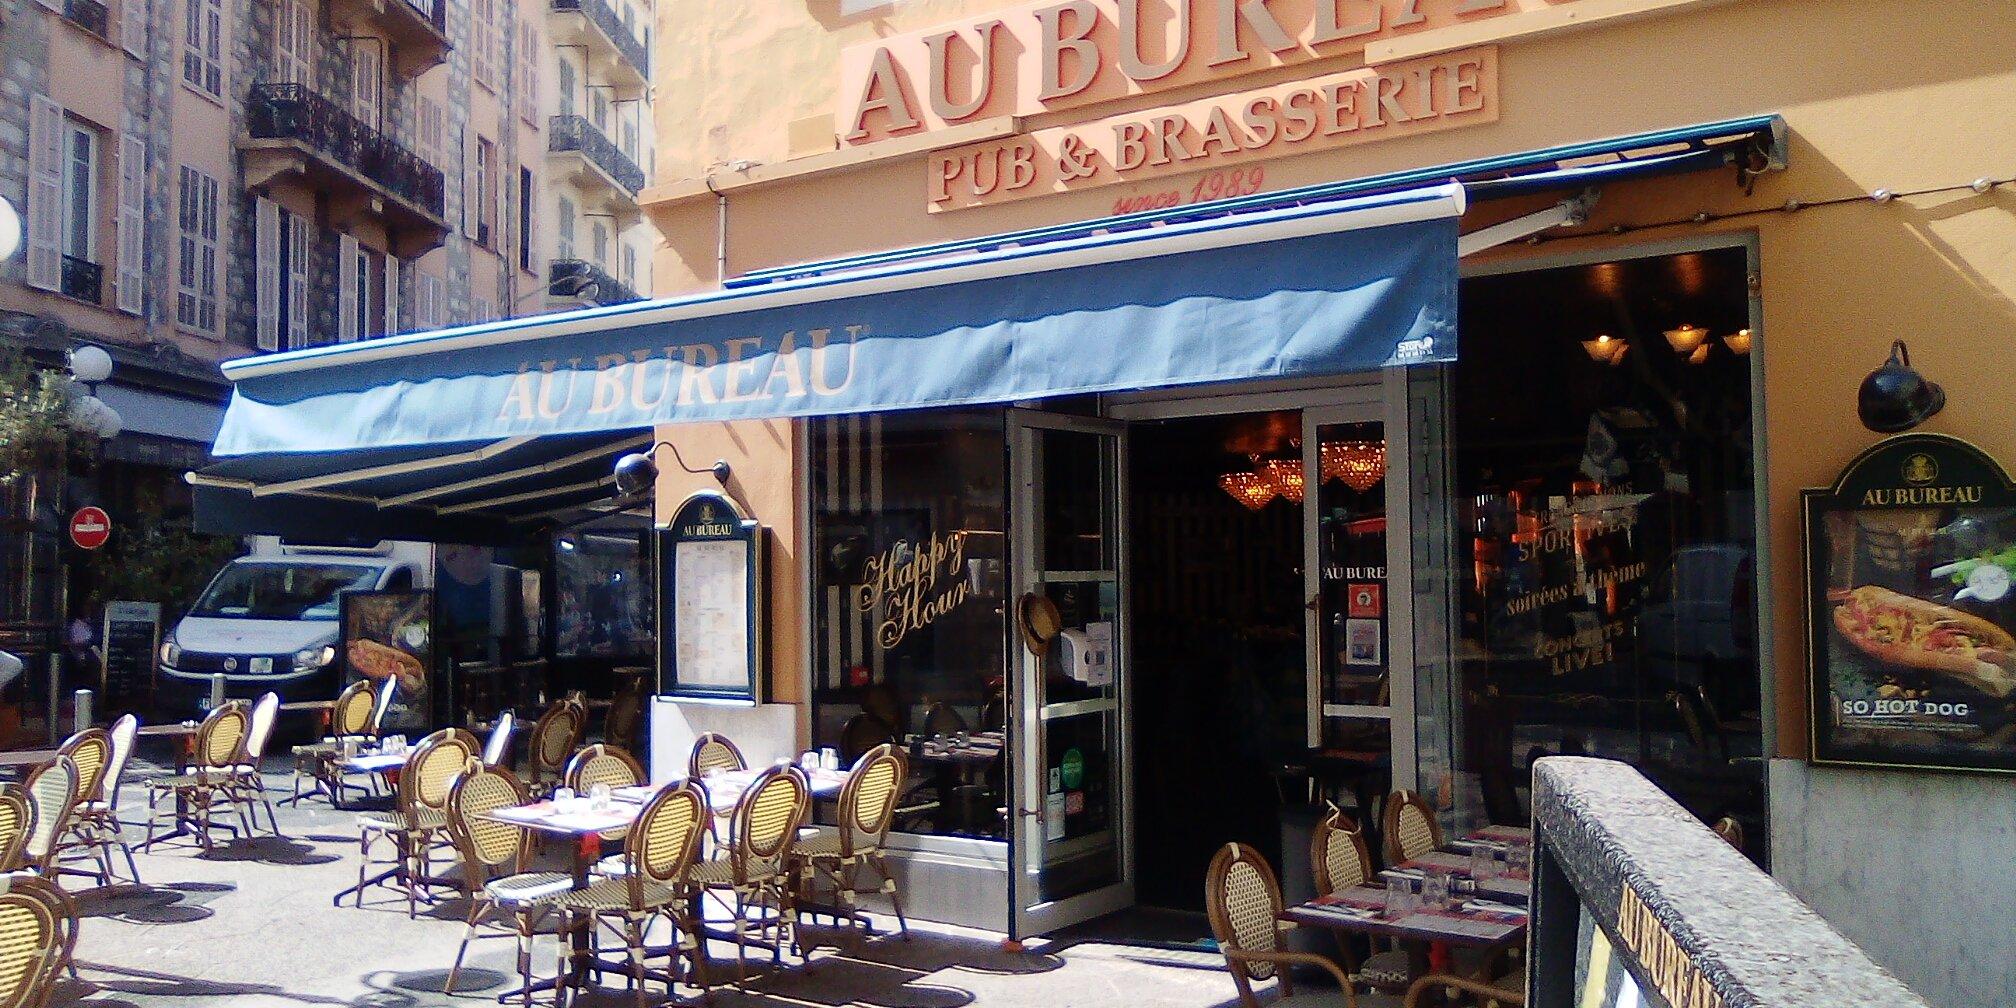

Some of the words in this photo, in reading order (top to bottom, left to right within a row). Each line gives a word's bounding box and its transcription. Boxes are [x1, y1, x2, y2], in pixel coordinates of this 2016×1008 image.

[846, 19, 1003, 142] AU
[934, 142, 1037, 204] PUB
[1057, 133, 1098, 180] &
[1112, 57, 1488, 174] BRASSERIE
[1112, 190, 1181, 216] since
[1190, 166, 1265, 205] 1989
[498, 355, 584, 421] AU
[588, 324, 864, 415] BUREAU
[1863, 488, 1892, 505] AU
[1895, 486, 1983, 505] BUREAU
[683, 525, 695, 536] AU
[696, 524, 733, 536] BUREAU
[858, 530, 967, 612] Happy
[1323, 566, 1344, 580] AU
[877, 576, 971, 650] Hour
[1842, 700, 1870, 714] SO
[1874, 699, 1920, 714] HOT
[1924, 702, 1970, 717] DOG
